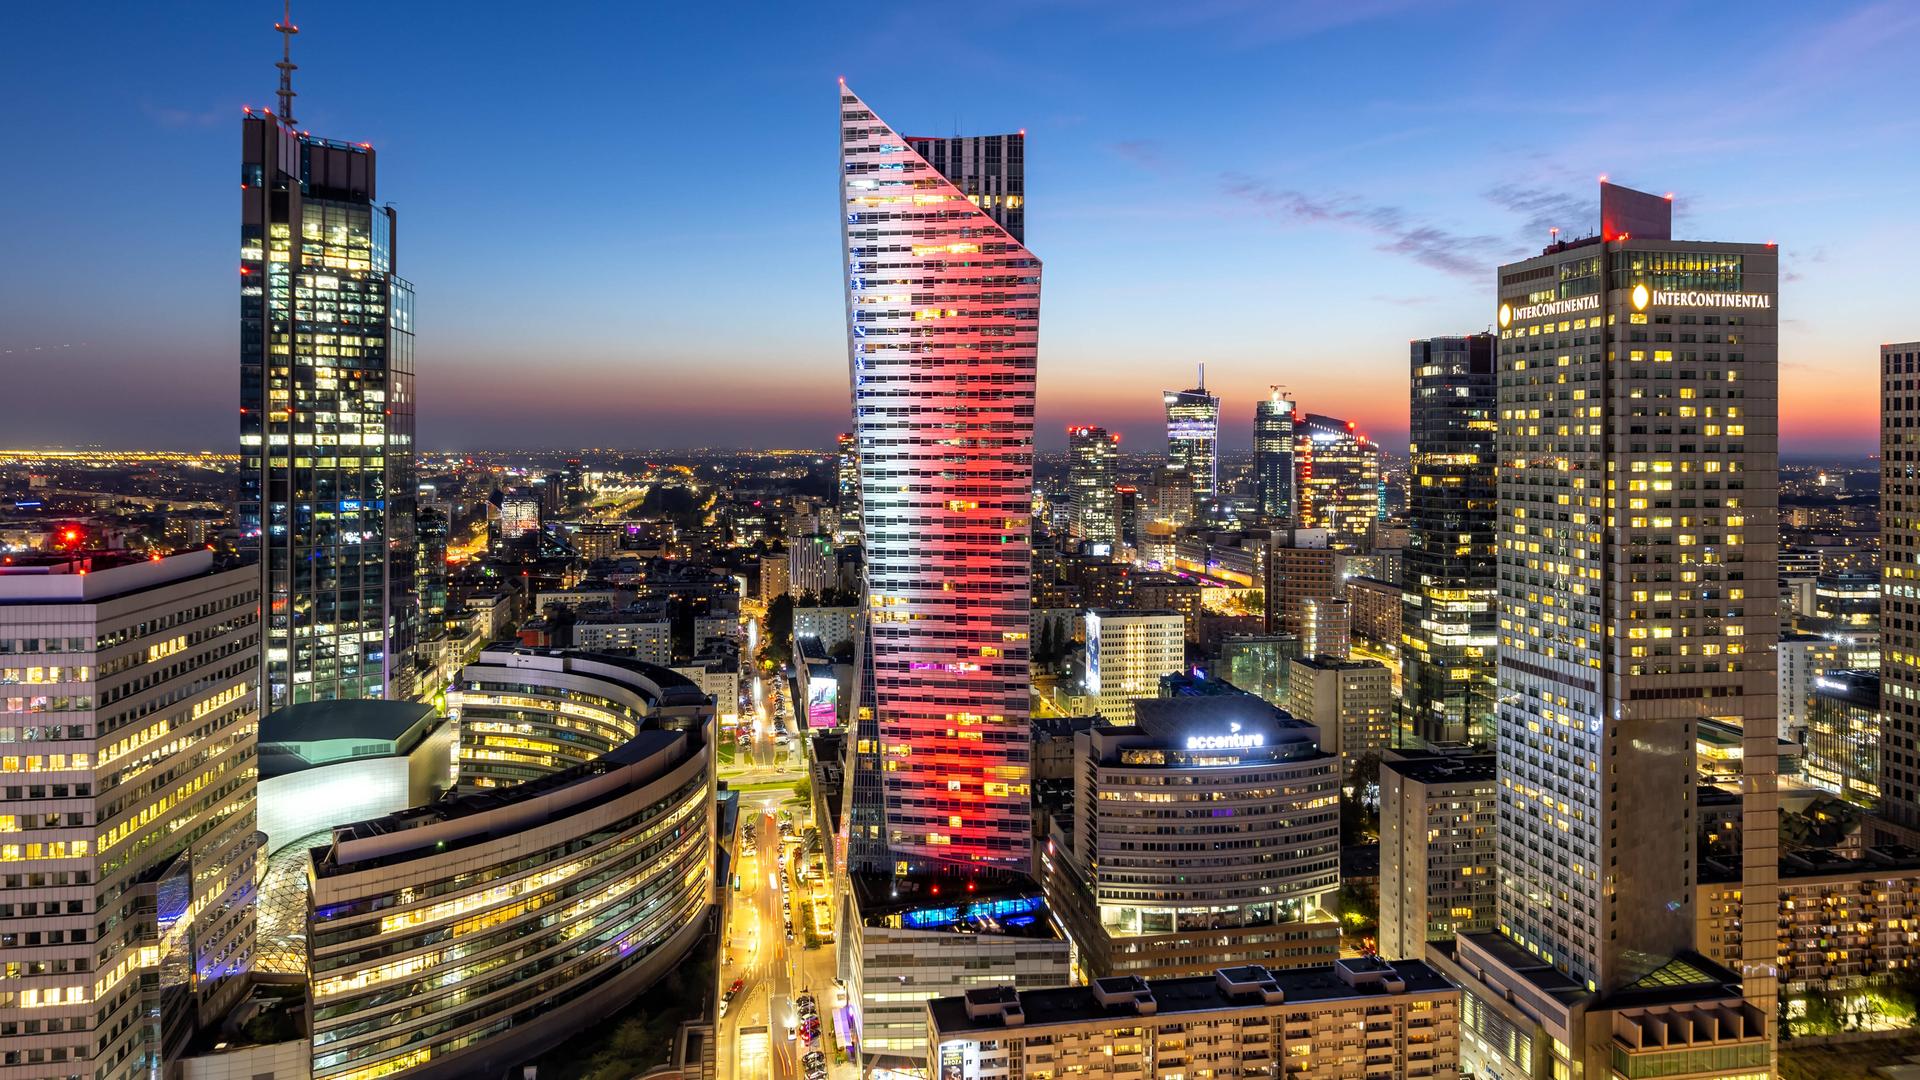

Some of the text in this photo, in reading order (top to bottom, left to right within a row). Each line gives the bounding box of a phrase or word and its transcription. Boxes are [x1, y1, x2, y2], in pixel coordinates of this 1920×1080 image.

[1512, 295, 1600, 321] INTERCONTINENTAL
[1653, 290, 1771, 308] INTERCONTINENTAL
[1187, 732, 1264, 749] accenture
